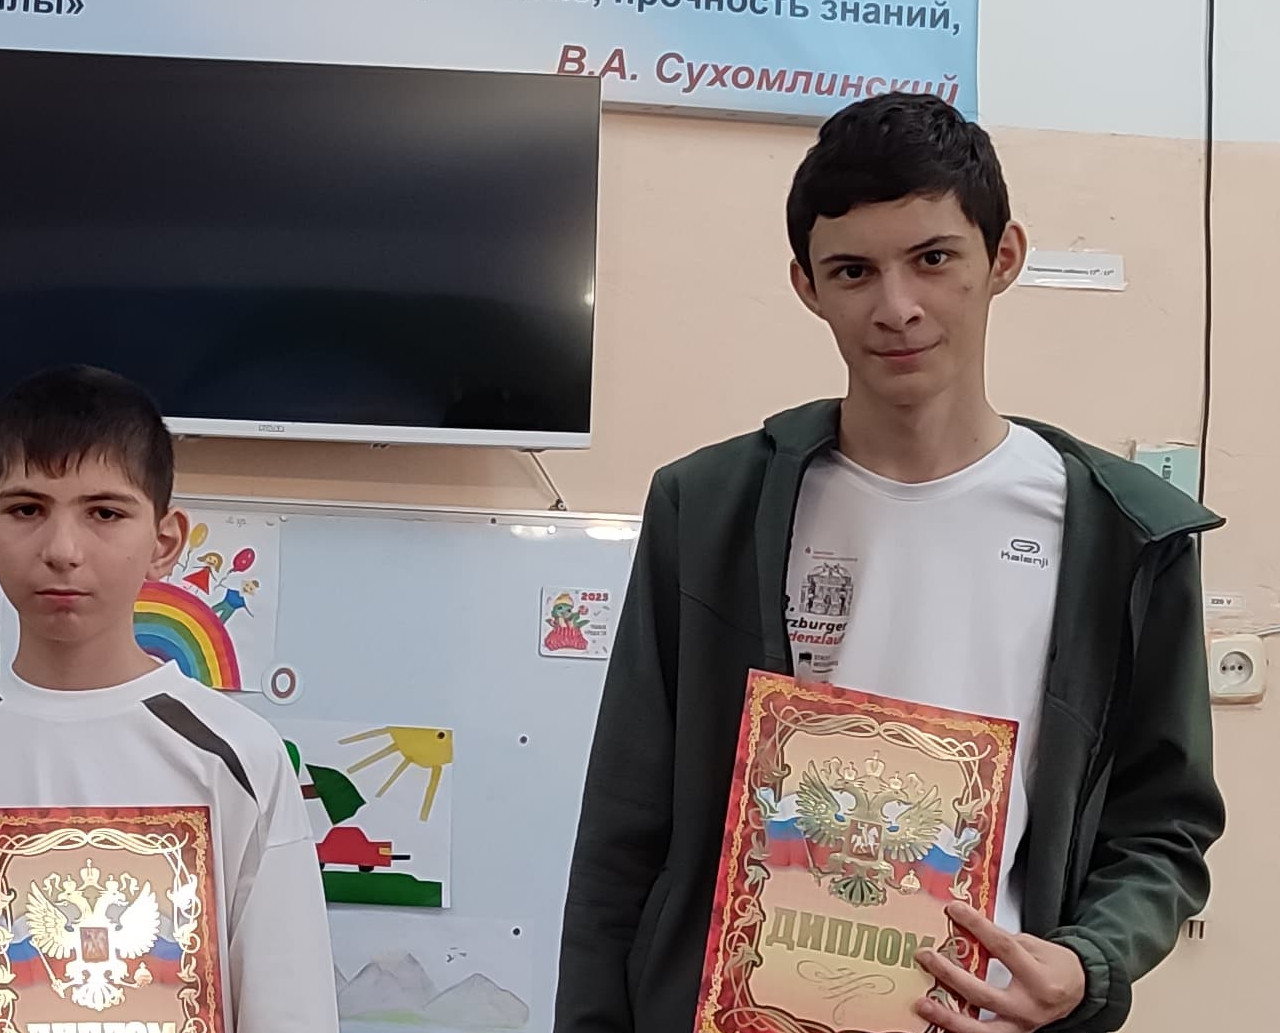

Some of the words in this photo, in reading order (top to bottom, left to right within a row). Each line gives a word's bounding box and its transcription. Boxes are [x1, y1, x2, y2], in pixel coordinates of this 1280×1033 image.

[615, 0, 810, 18] ность
[820, 0, 961, 35] знаний,
[556, 44, 638, 81] В.А.
[787, 617, 847, 635] zburger
[765, 906, 936, 970] ДИПЛОМ
